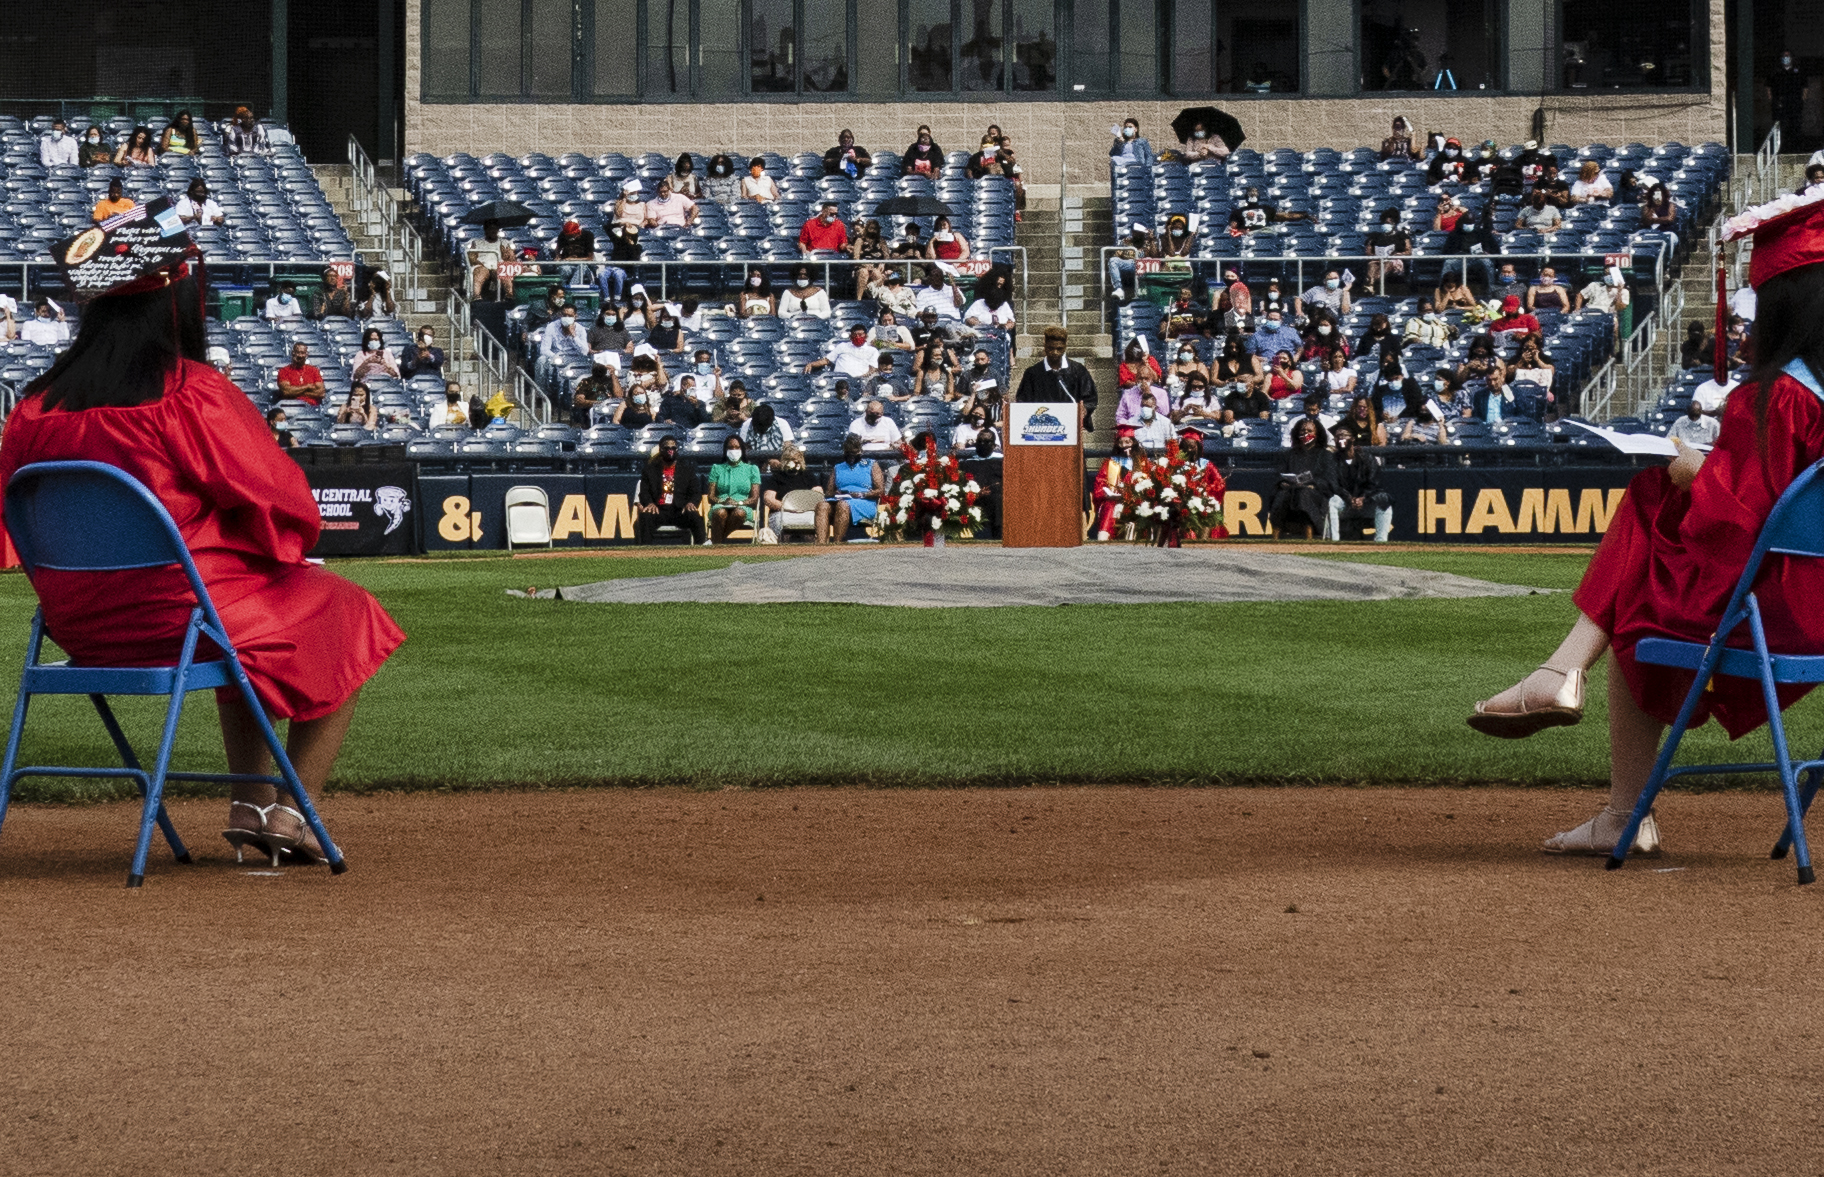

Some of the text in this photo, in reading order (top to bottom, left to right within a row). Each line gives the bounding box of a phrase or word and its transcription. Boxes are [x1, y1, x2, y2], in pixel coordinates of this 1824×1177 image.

[498, 264, 522, 276] 209
[967, 263, 990, 275] 209
[1137, 261, 1160, 273] 210
[321, 488, 372, 503] CENTRAL
[1418, 488, 1627, 534] HAMM
[438, 495, 483, 542] &
